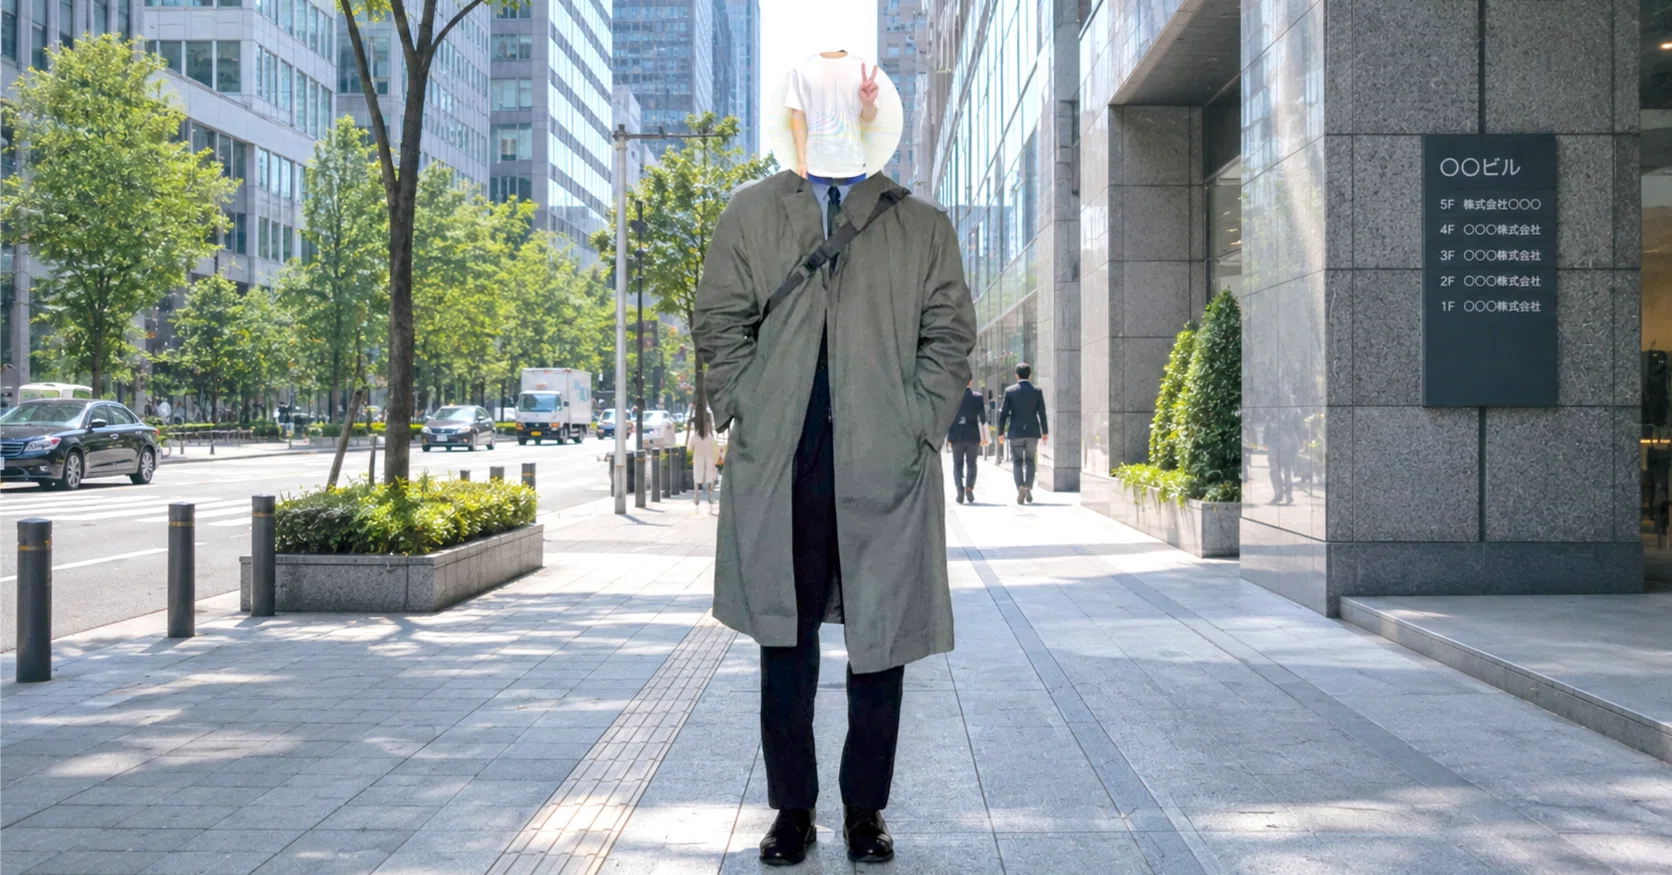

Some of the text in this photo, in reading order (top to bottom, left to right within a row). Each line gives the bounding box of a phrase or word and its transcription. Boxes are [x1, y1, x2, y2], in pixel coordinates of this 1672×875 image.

[1440, 199, 1455, 210] 5F
[1440, 224, 1455, 235] 4F
[1440, 249, 1455, 261] 3F
[1440, 275, 1455, 287] 2F
[1441, 301, 1455, 312] 1F
